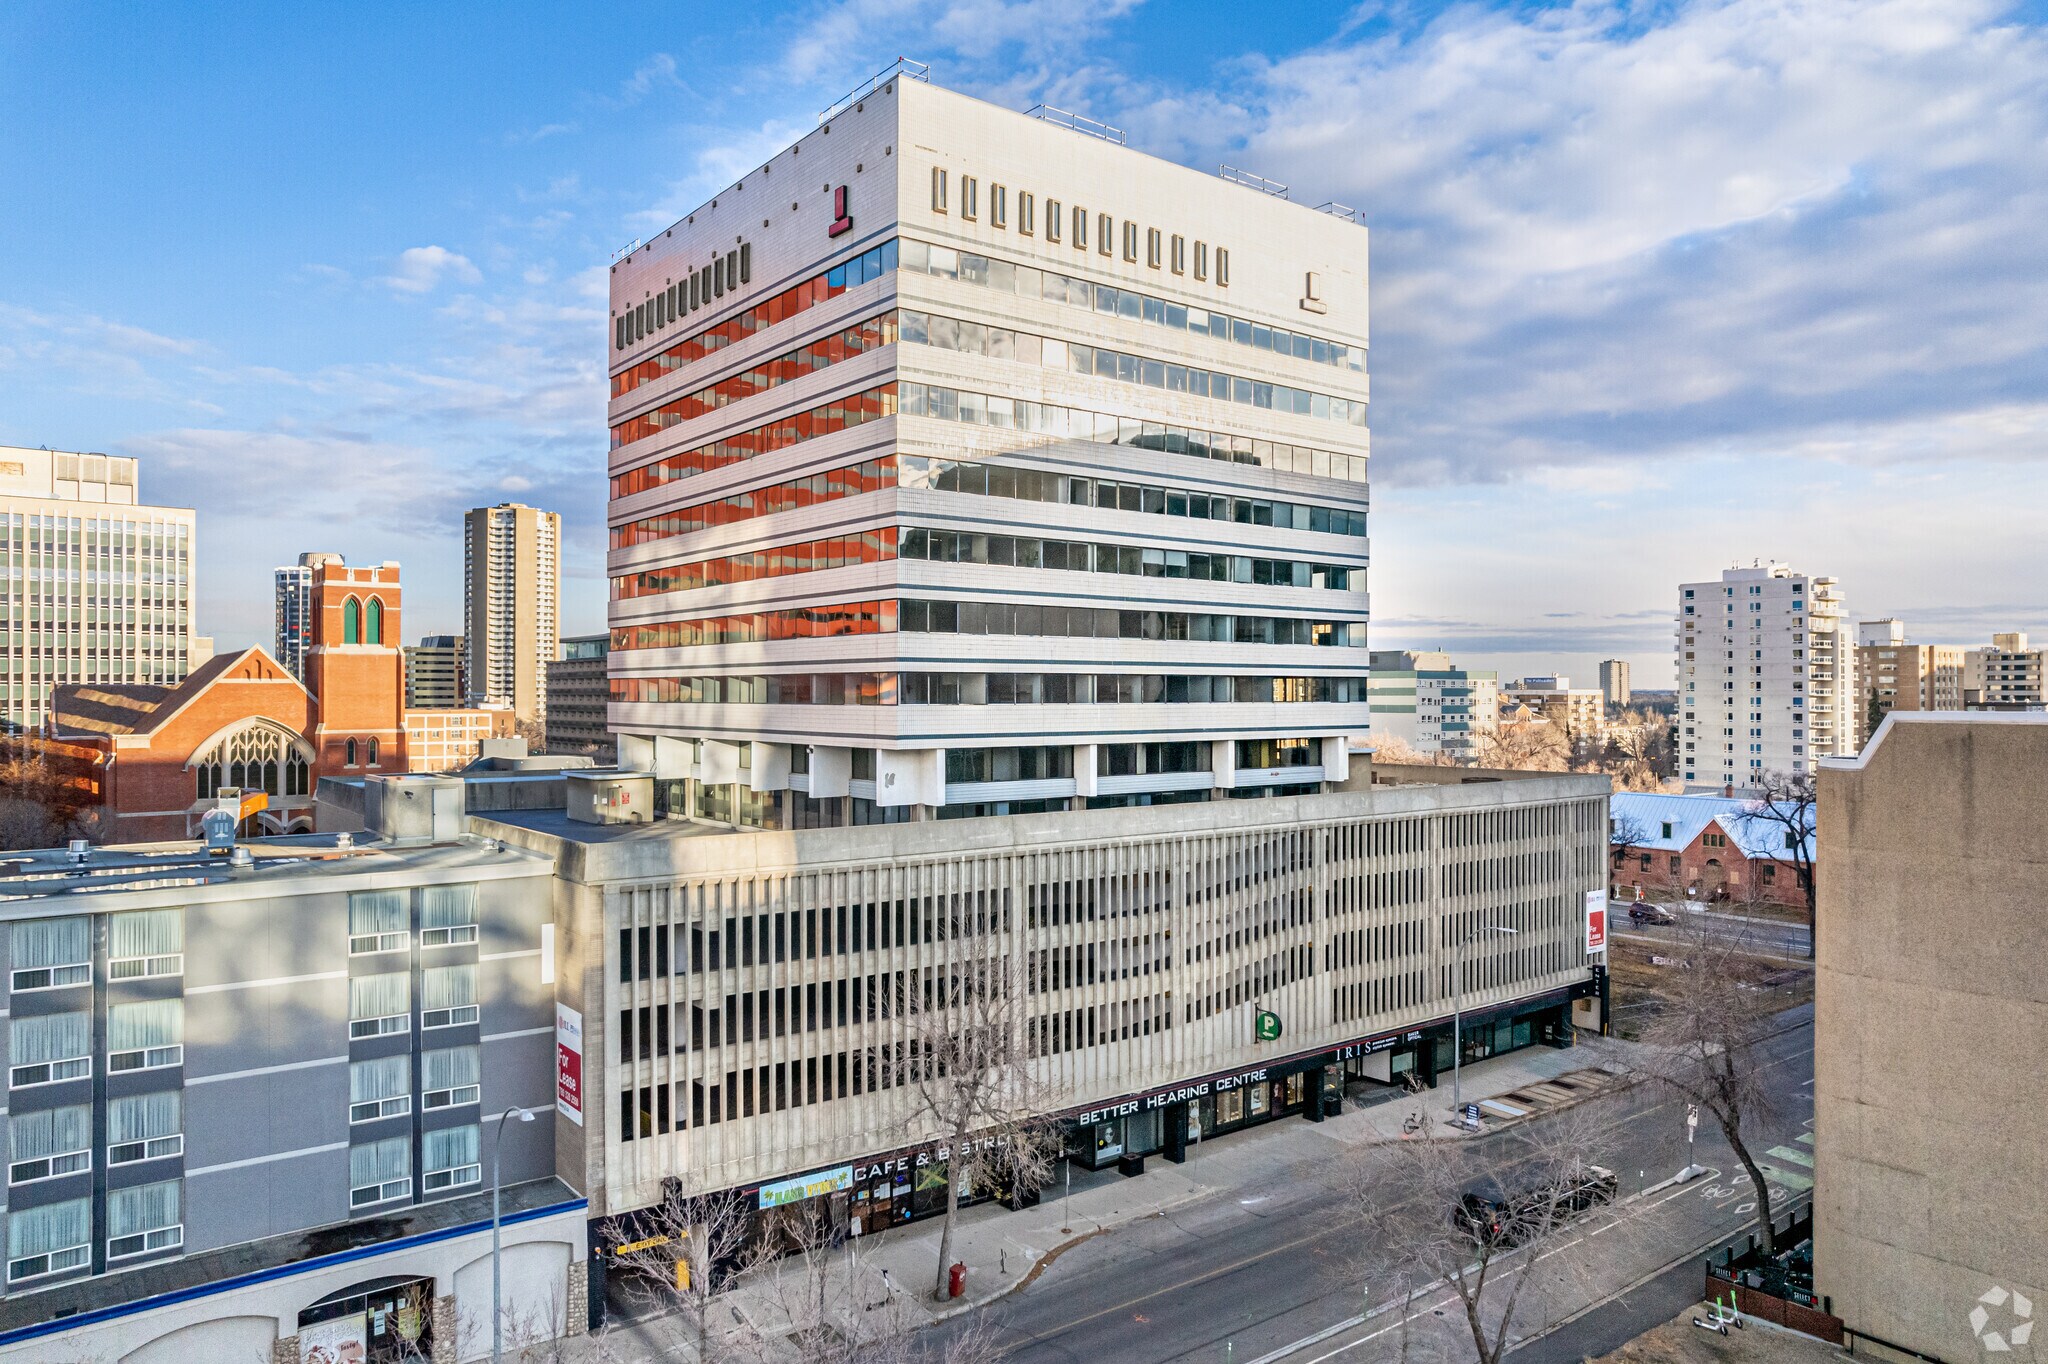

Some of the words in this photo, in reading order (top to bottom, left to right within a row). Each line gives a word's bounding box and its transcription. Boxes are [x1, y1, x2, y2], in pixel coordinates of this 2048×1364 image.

[1264, 1015, 1275, 1030] P
[559, 1047, 569, 1068] For
[1336, 1041, 1372, 1061] IRIS
[559, 1065, 576, 1092] Lease
[1080, 1100, 1139, 1126] BETTER
[1147, 1083, 1209, 1109] HEARING
[1216, 1068, 1267, 1091] CENTRE
[854, 1156, 909, 1181] CAFE
[916, 1152, 930, 1167] &
[939, 1134, 1011, 1161] BSTRO
